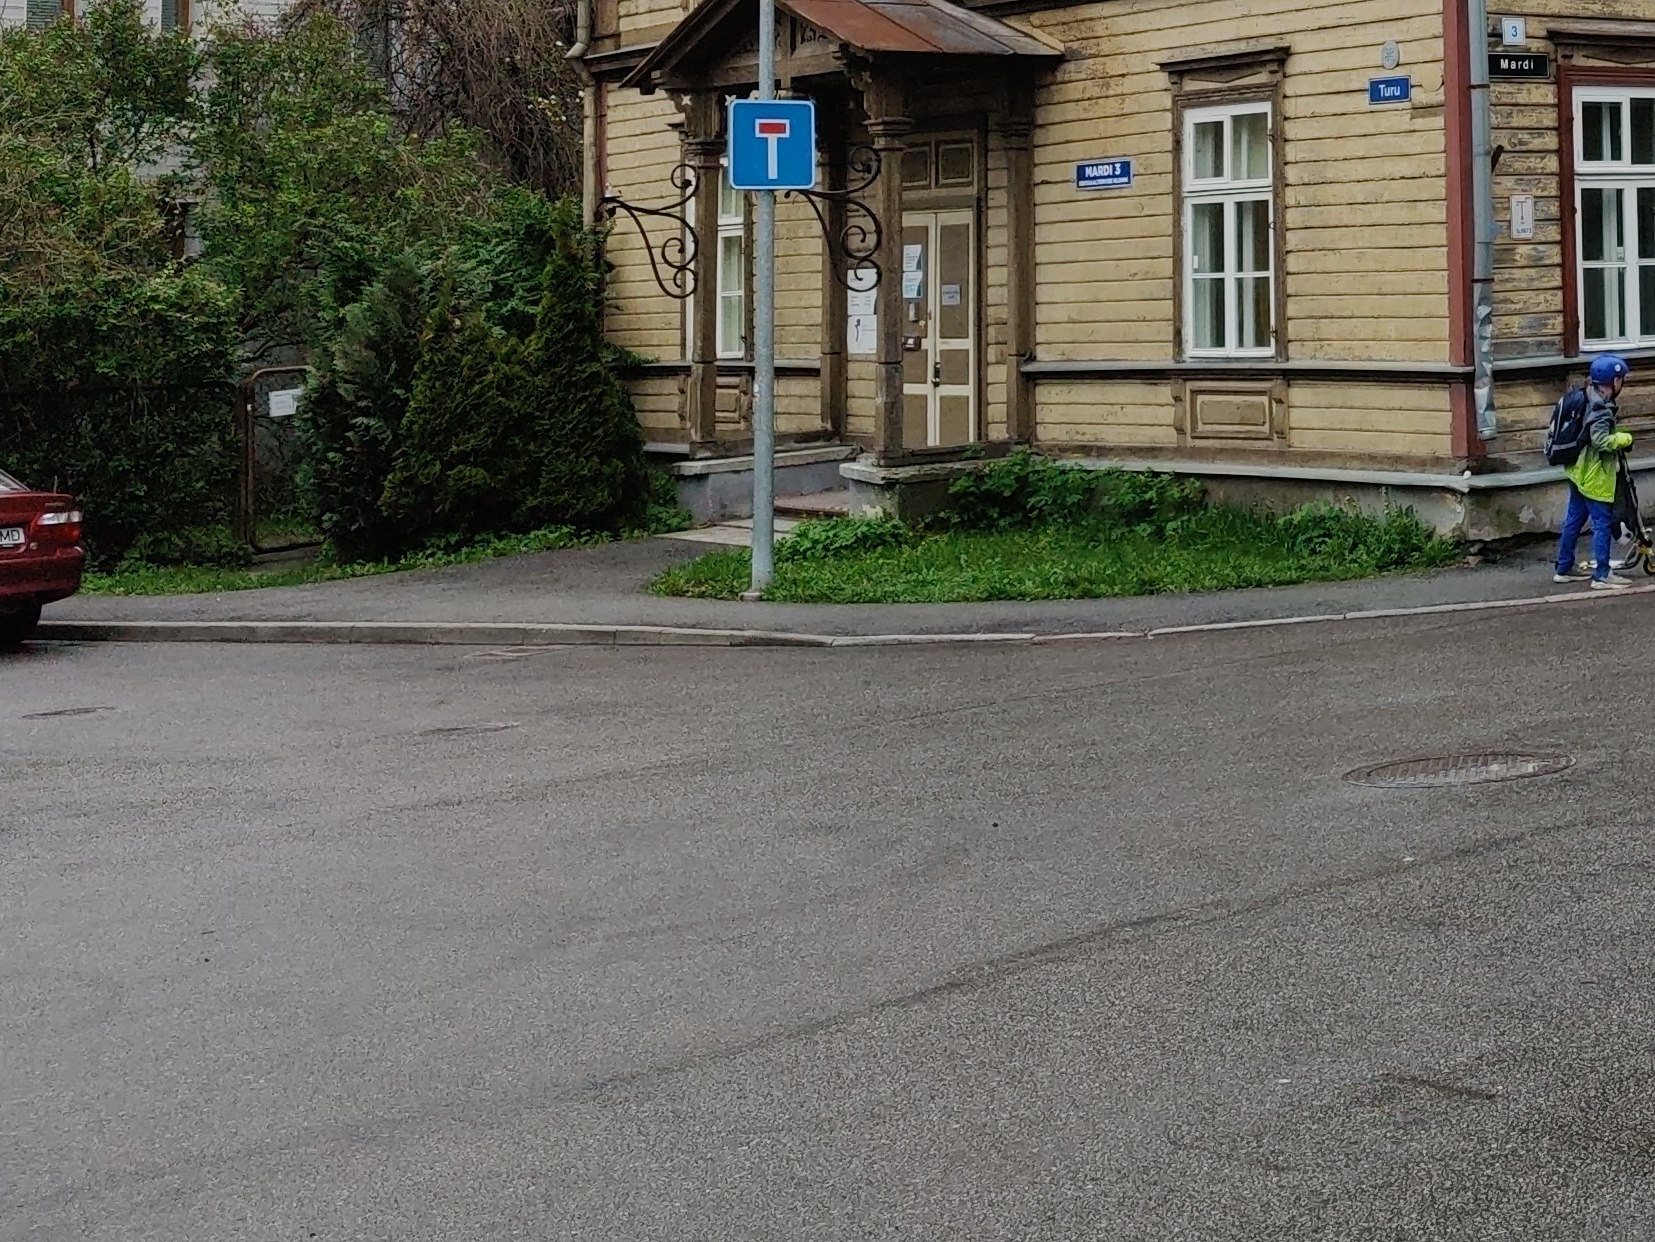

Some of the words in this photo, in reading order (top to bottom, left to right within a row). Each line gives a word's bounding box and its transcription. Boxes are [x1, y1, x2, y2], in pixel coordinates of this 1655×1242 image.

[1511, 25, 1518, 37] 3
[1500, 58, 1534, 70] Mardi
[1378, 84, 1401, 97] Turu
[1085, 164, 1113, 178] MARDI
[1114, 163, 1121, 175] 3
